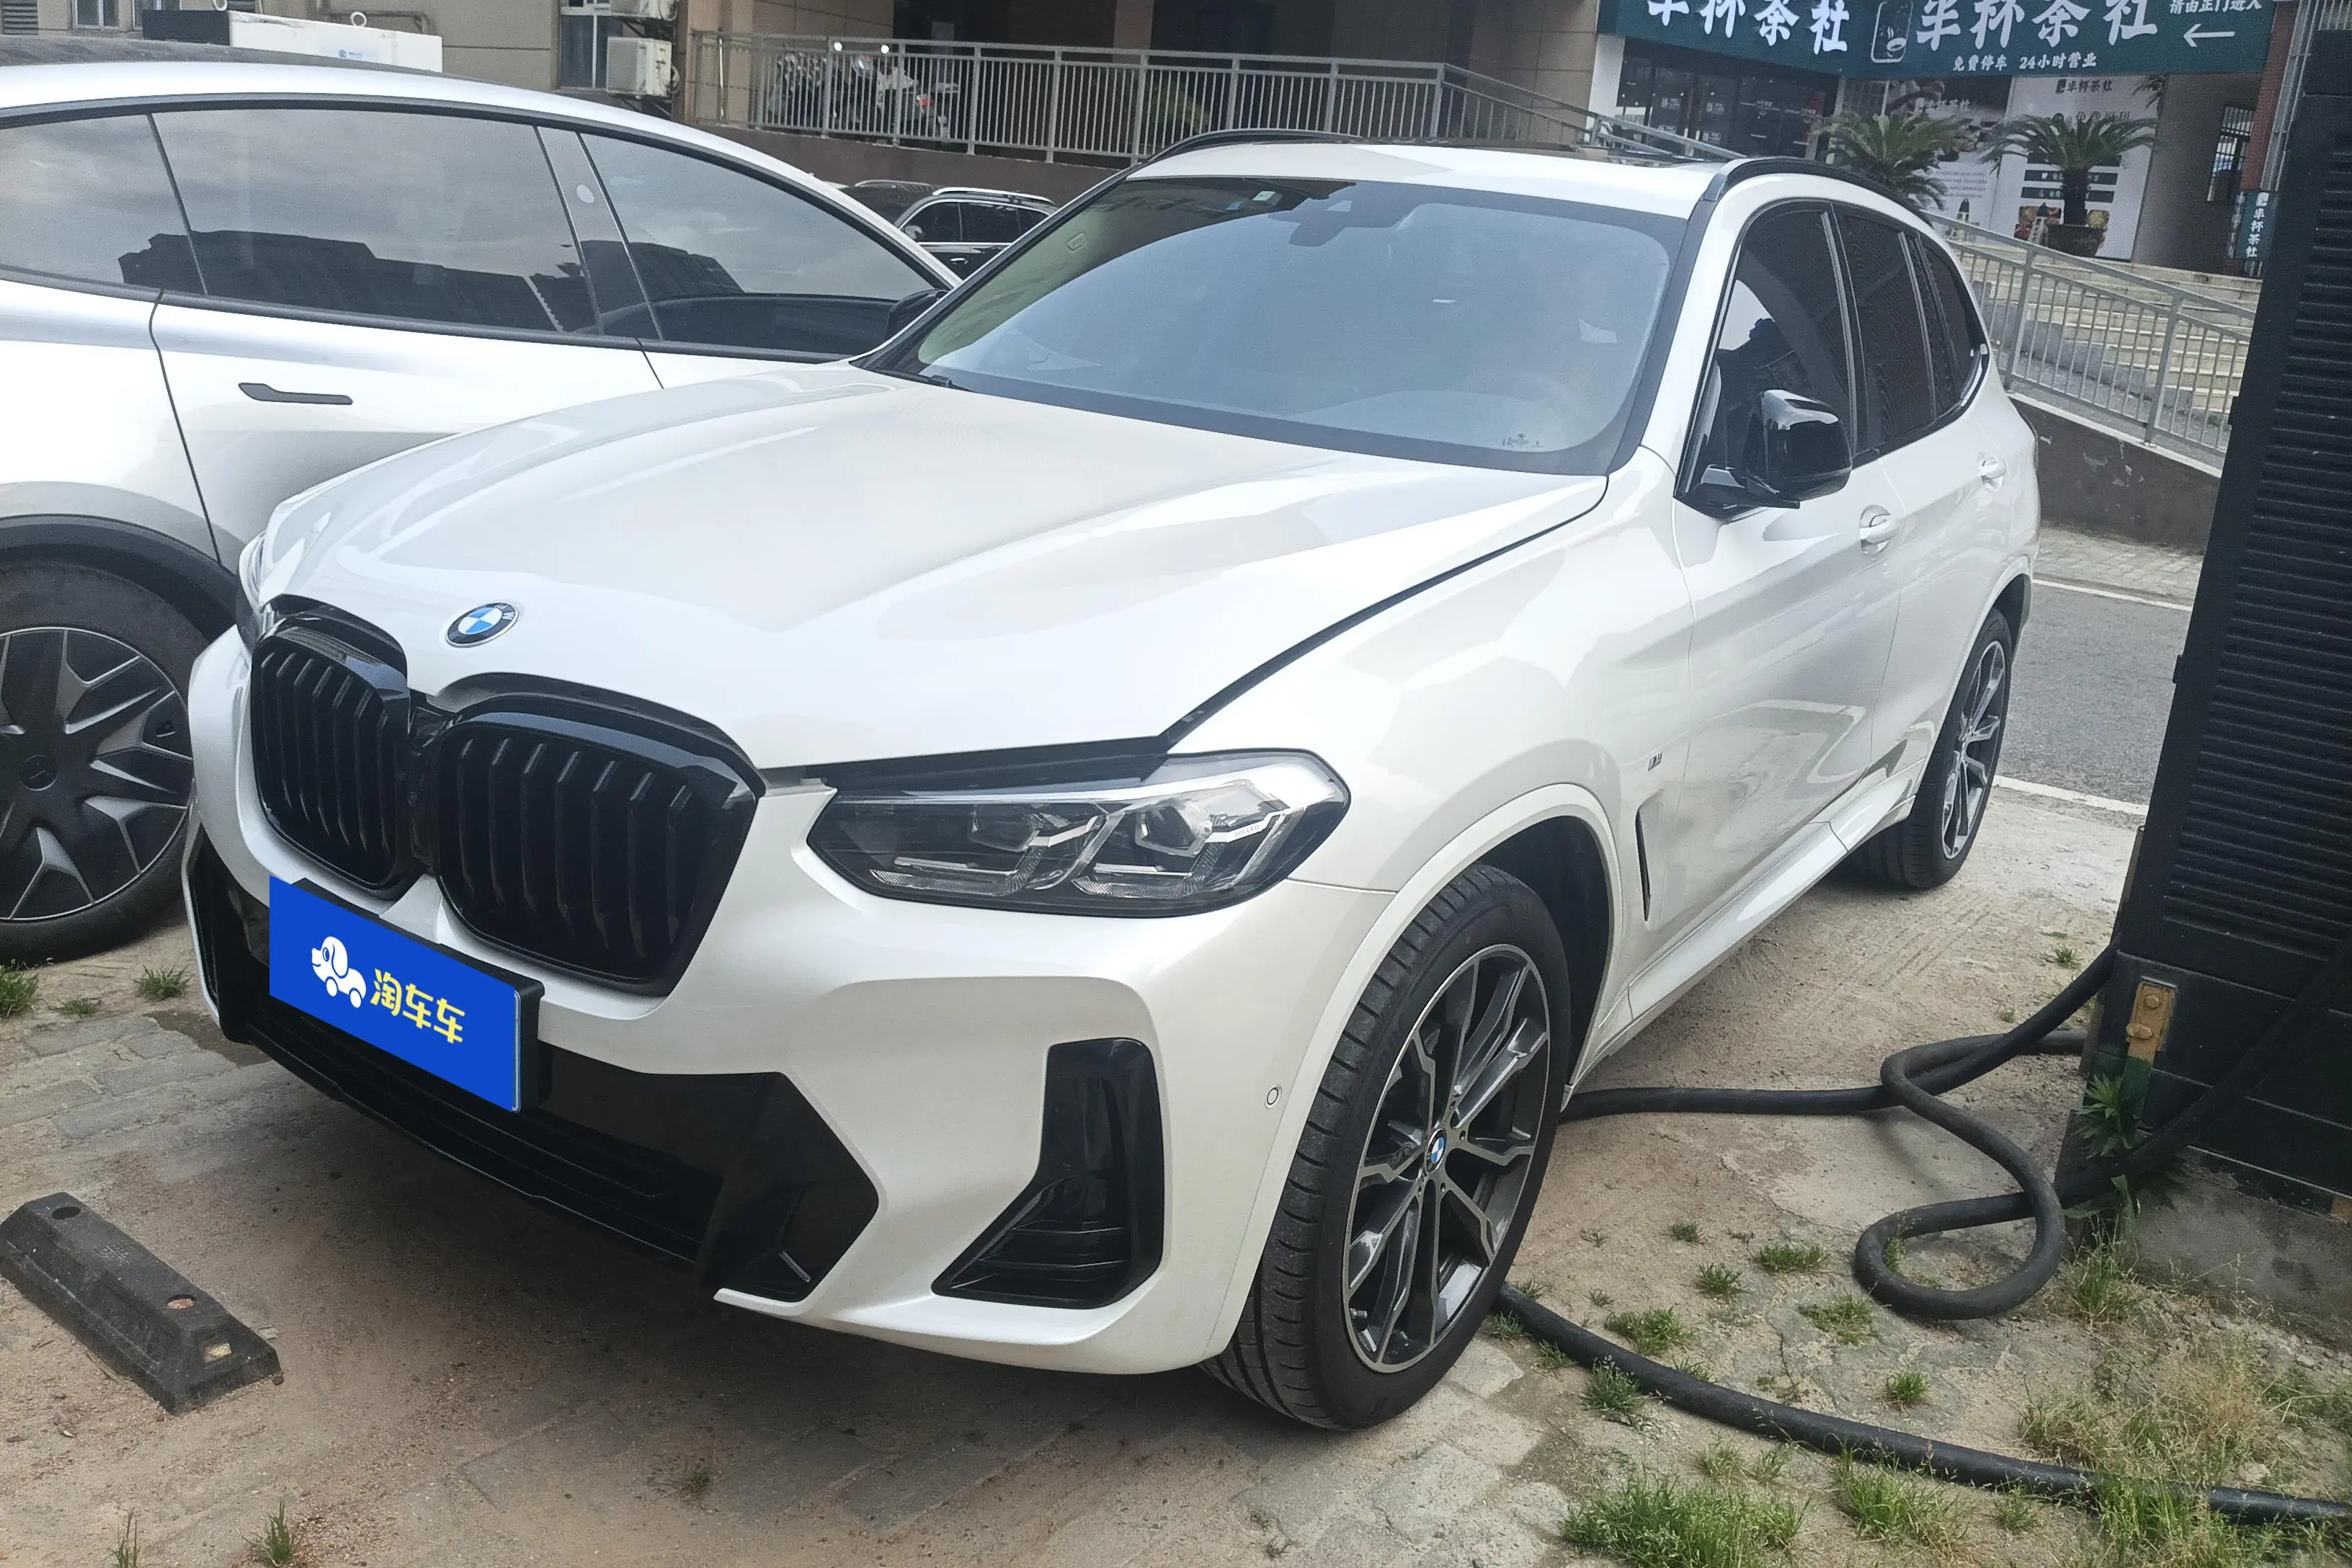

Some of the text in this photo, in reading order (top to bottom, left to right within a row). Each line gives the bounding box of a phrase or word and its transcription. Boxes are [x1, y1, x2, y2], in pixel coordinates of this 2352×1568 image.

[1953, 51, 2097, 71] 免费停车 24小时营业
[2246, 208, 2265, 258] 半杯茶社
